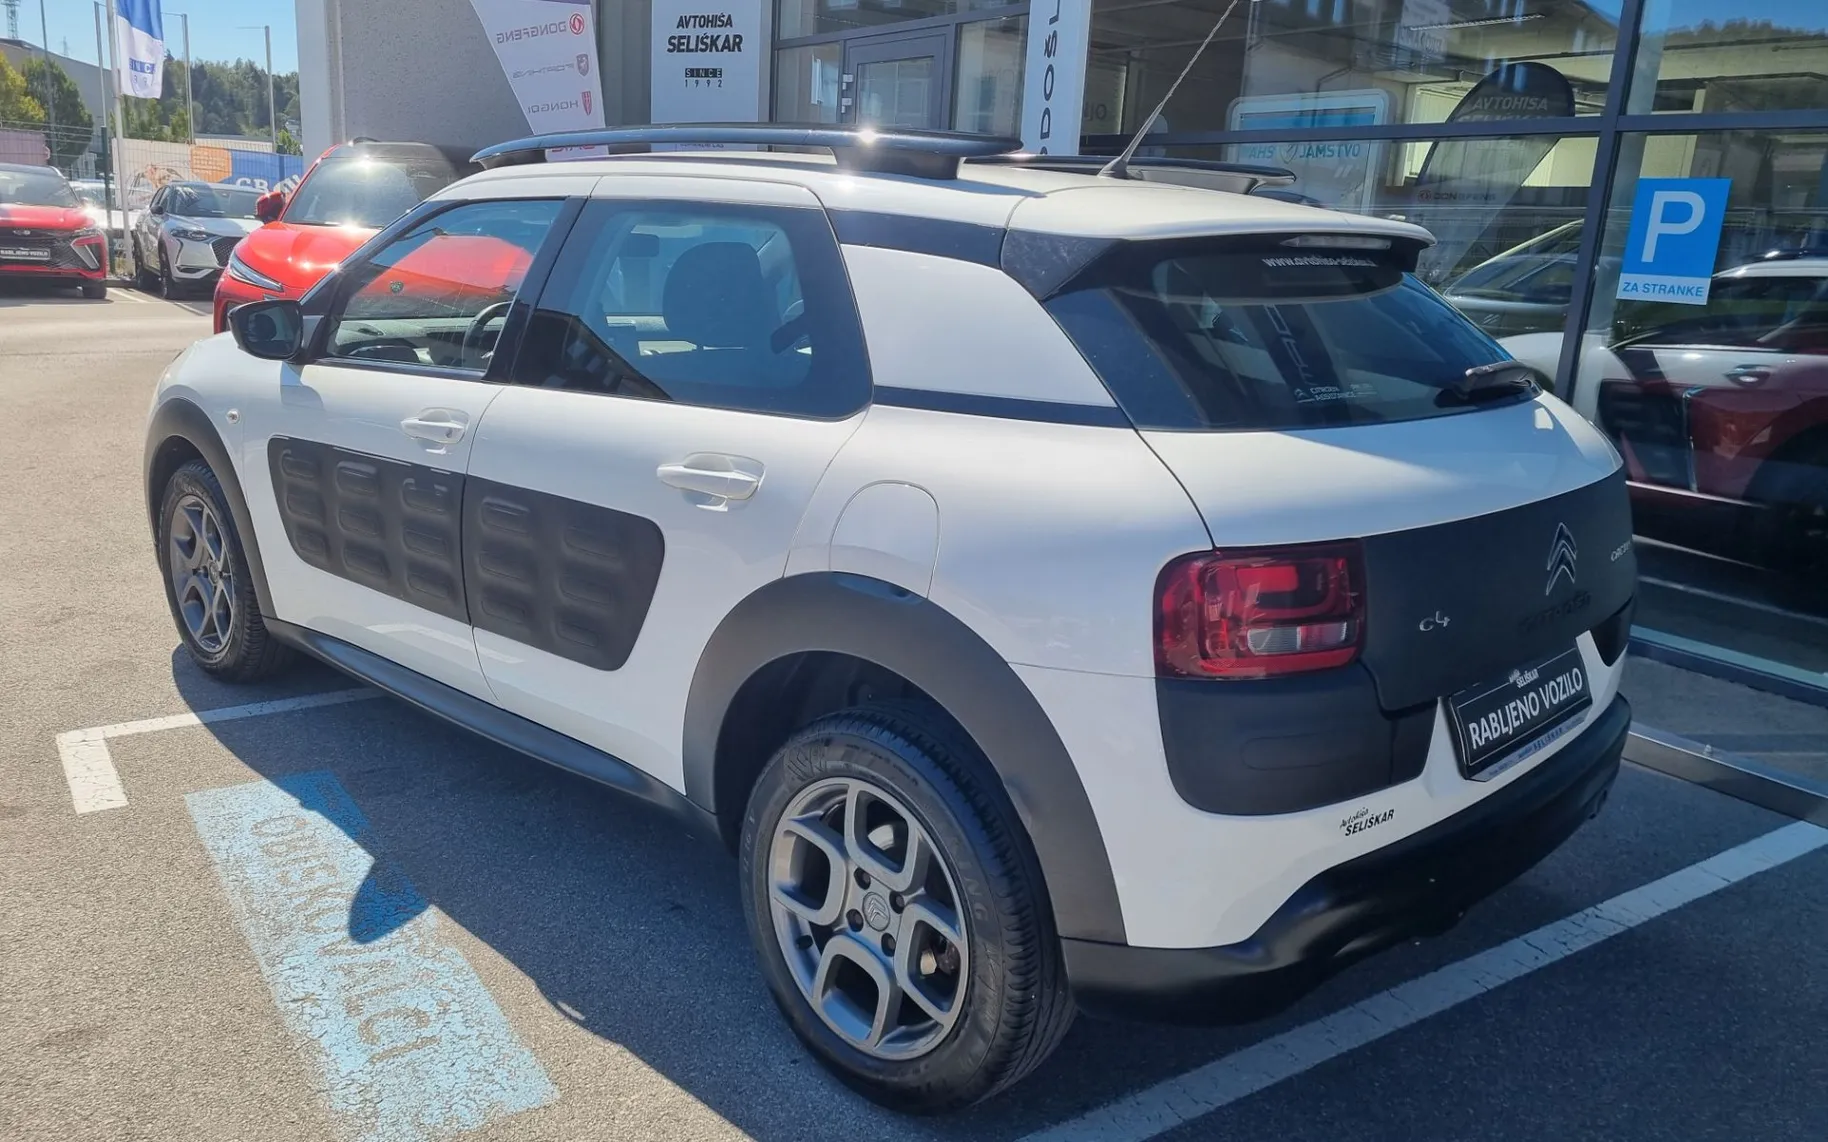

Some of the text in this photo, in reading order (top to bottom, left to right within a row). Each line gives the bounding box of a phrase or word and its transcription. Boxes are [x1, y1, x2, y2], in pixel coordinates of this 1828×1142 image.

[667, 32, 743, 53] SELIŠKAR
[685, 68, 722, 78] SINCE
[685, 80, 722, 88] 1992
[1299, 143, 1360, 158] JAMSTVO
[1641, 190, 1706, 263] P
[1622, 281, 1704, 297] ZA STRANKE
[1419, 610, 1450, 632] C4
[1468, 667, 1583, 750] RABLJENO VOZILO
[1345, 808, 1395, 837] SELIŠKAR
